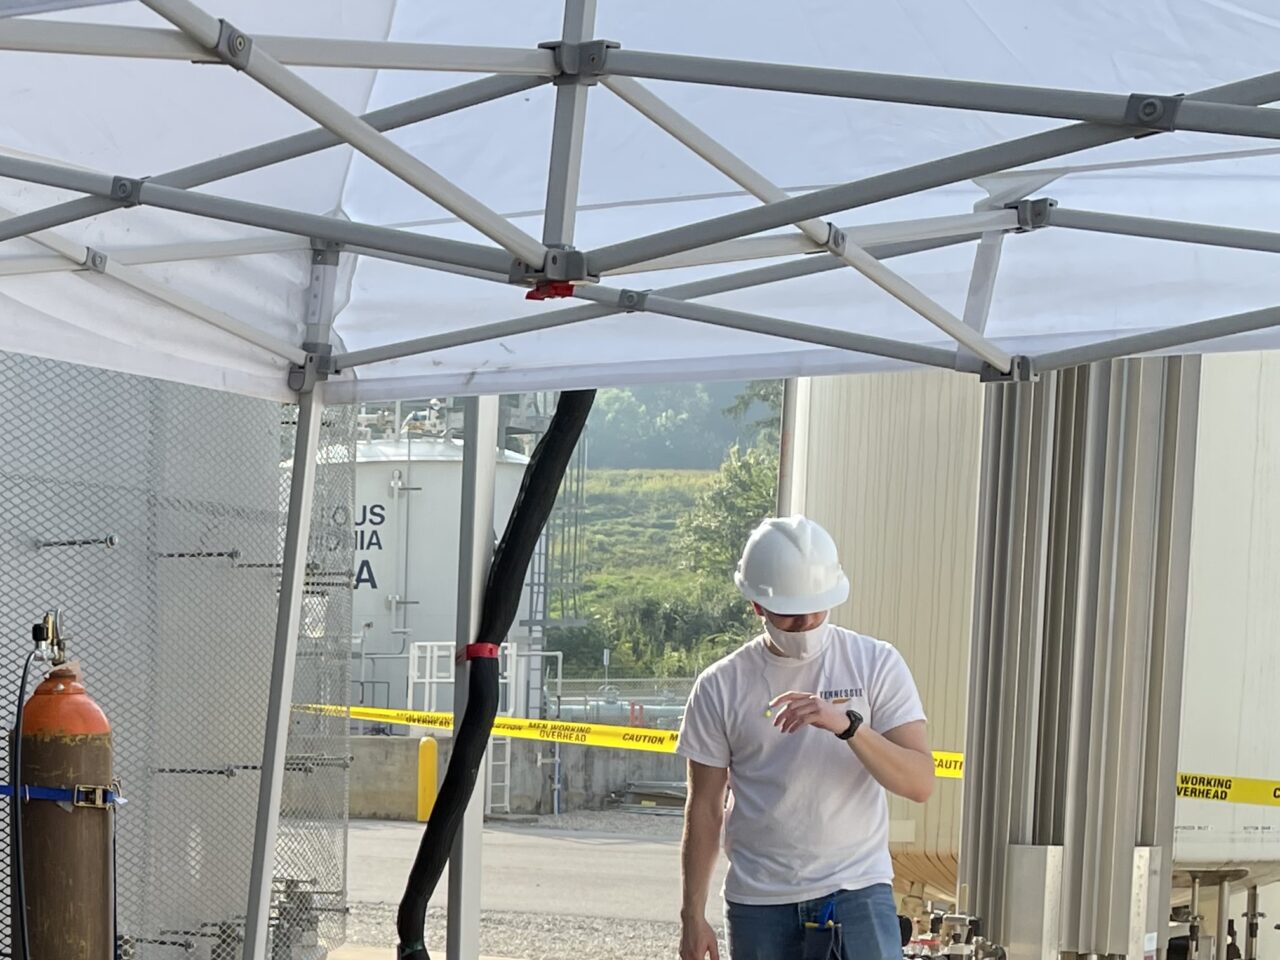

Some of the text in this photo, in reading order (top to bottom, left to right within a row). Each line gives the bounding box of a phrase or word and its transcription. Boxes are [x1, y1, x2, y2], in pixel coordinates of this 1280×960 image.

[820, 688, 863, 699] TENNESSEE
[528, 722, 592, 734] MEN WORKING
[539, 730, 587, 742] OVERHEAD
[622, 733, 665, 745] CAUTION
[1180, 775, 1232, 789] WORKING
